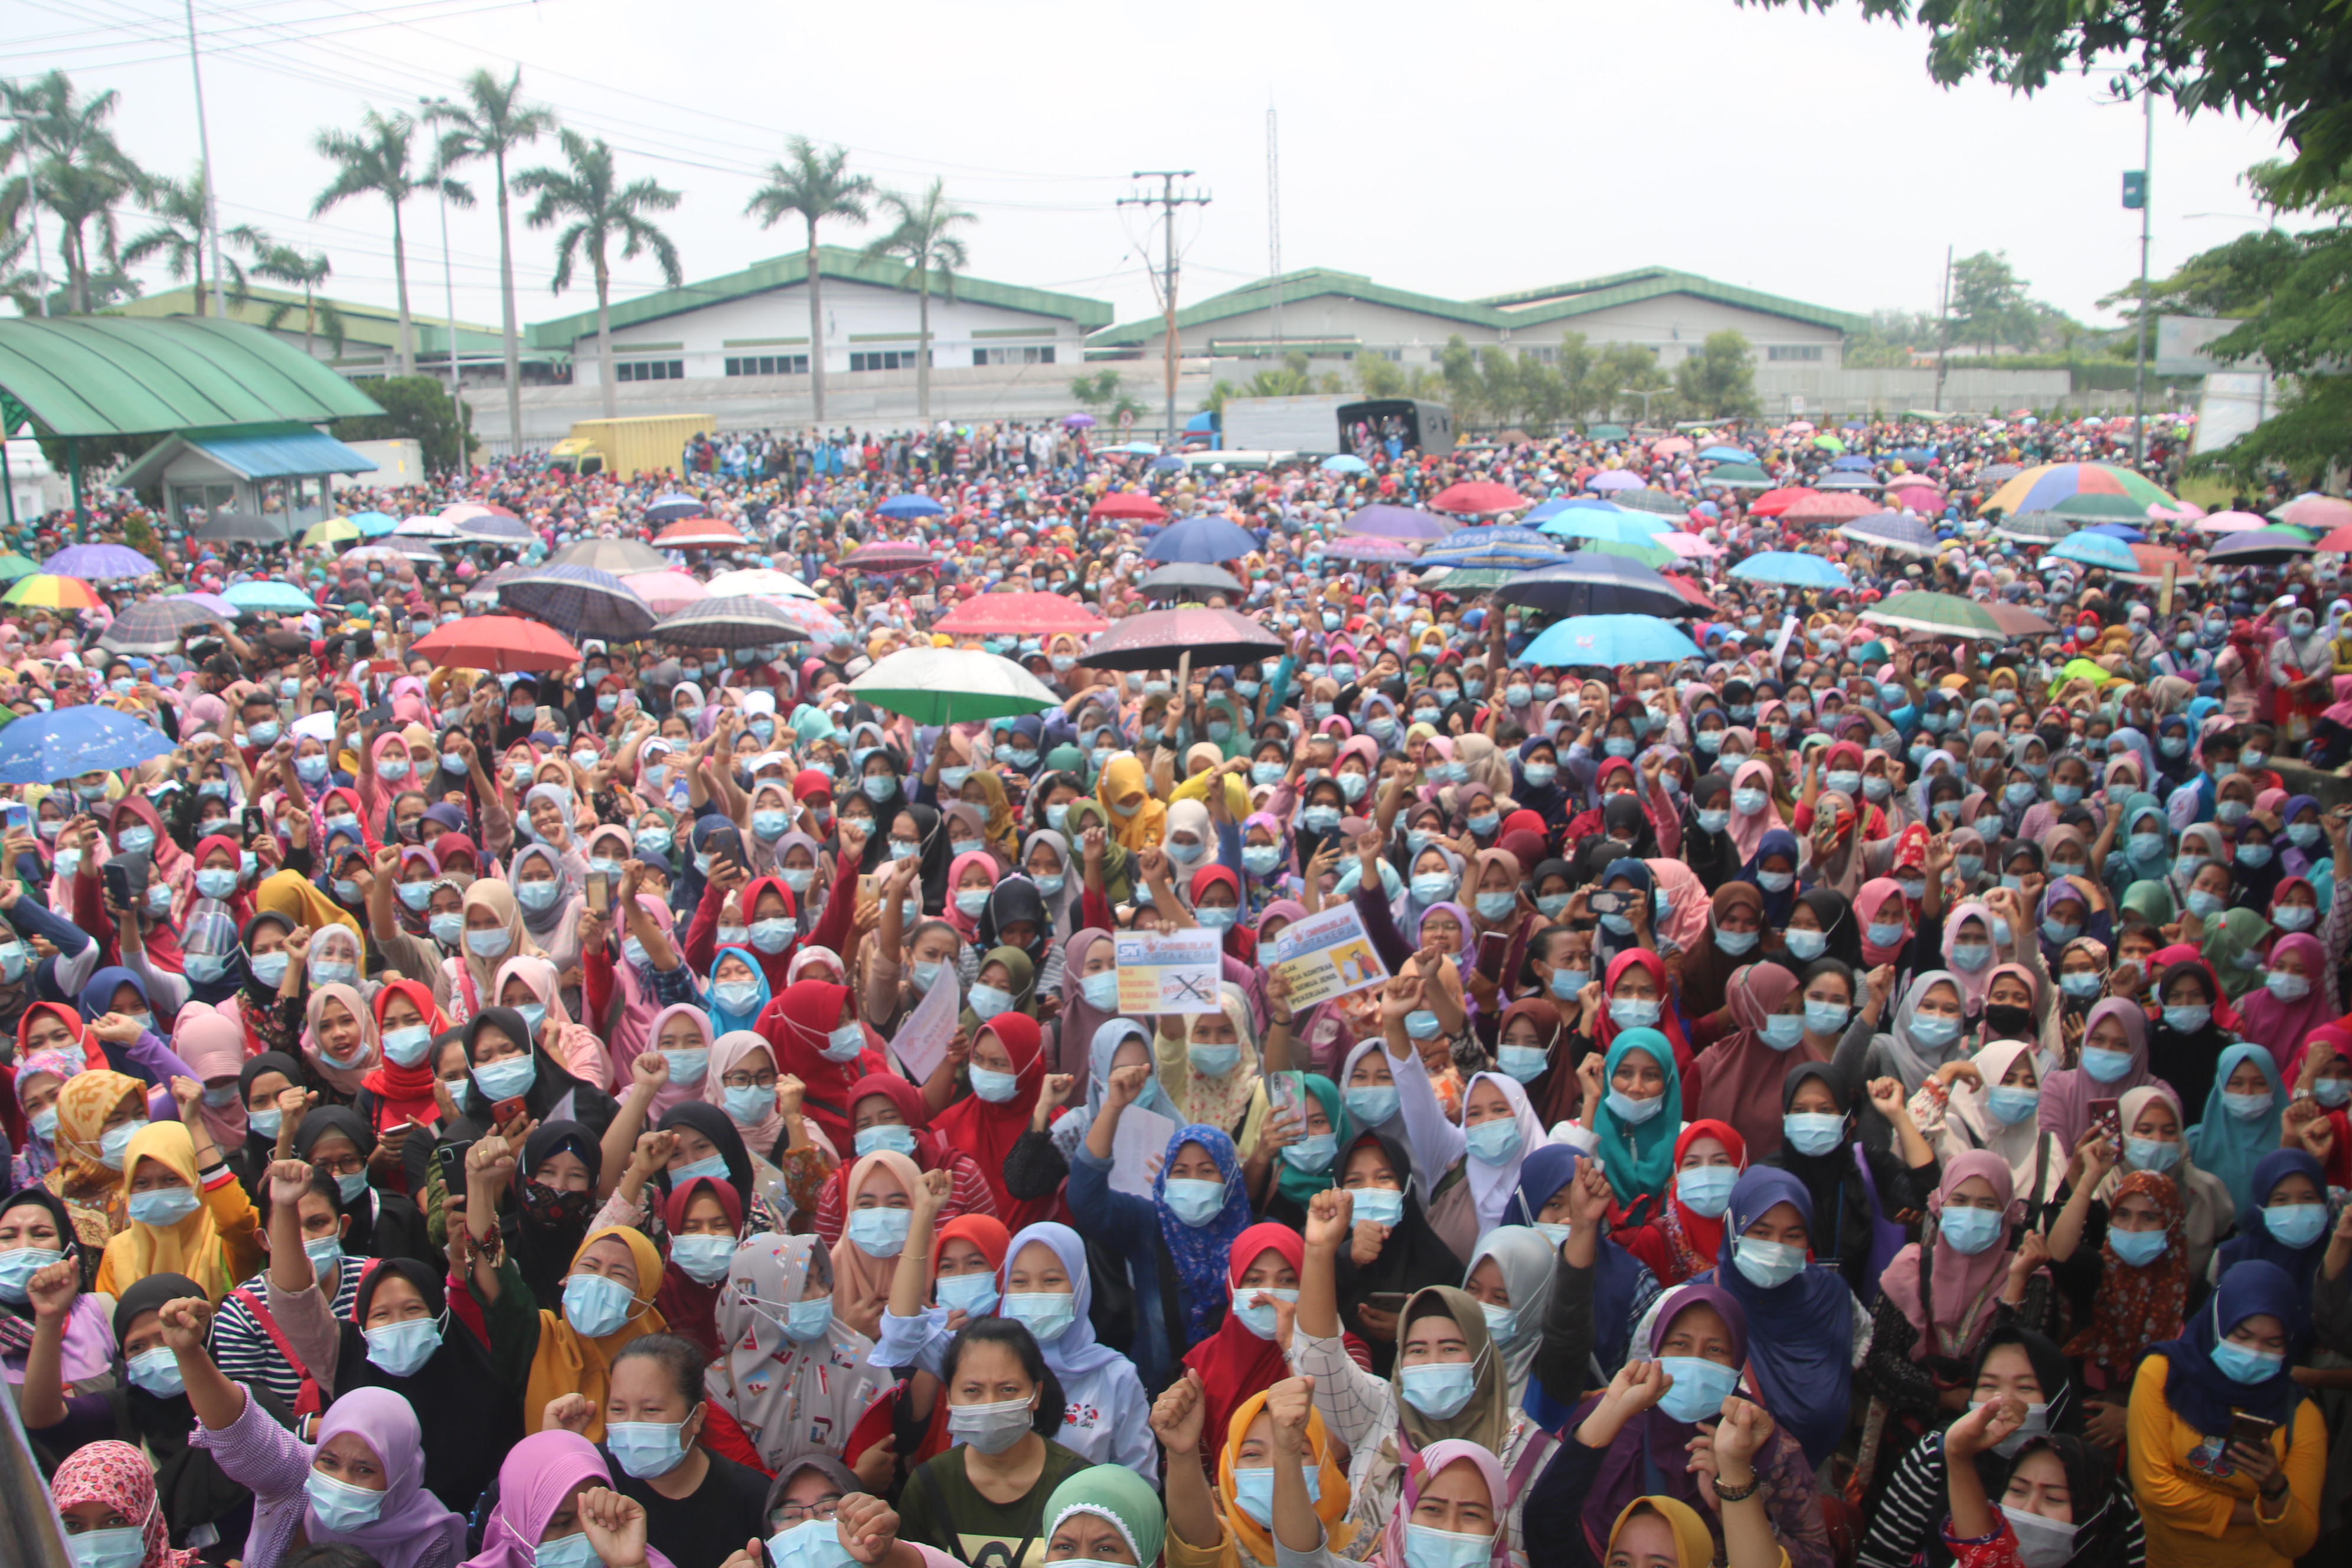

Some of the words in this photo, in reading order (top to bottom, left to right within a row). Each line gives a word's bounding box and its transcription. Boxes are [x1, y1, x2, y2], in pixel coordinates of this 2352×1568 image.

[1295, 936, 1322, 952] CIPTA
[1325, 923, 1357, 939] KERJA
[1144, 952, 1175, 961] CIPTA
[1180, 950, 1216, 960] KERJA
